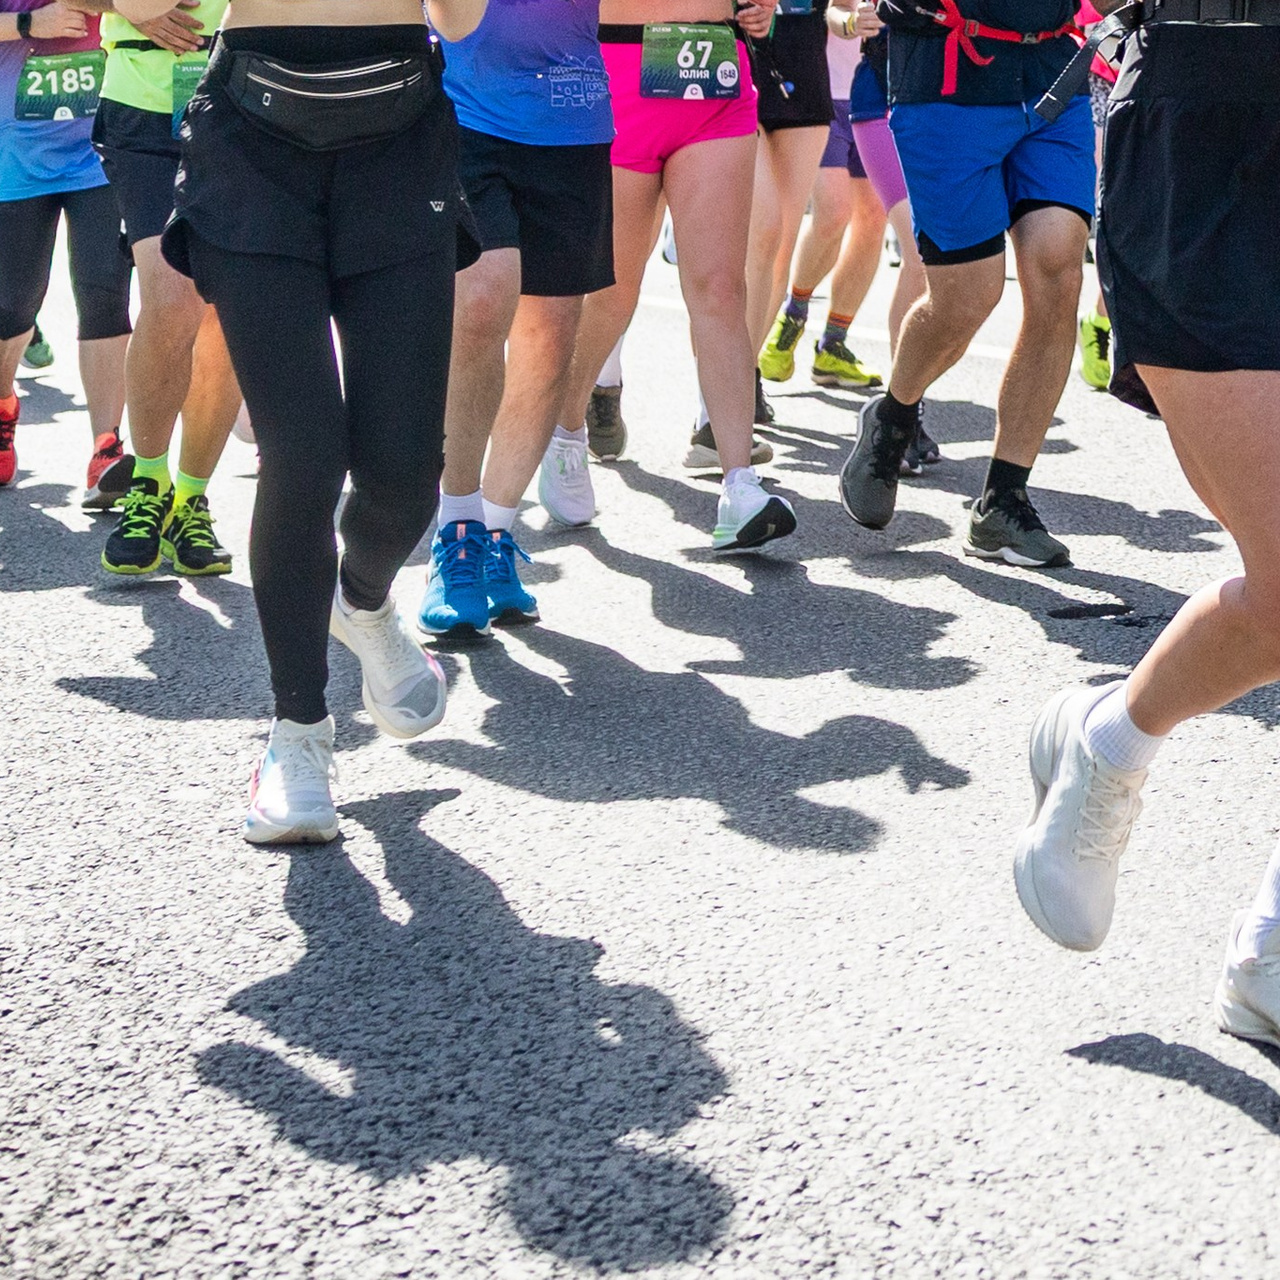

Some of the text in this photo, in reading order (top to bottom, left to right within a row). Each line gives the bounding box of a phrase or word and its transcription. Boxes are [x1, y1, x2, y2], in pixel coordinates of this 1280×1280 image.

[677, 40, 713, 69] 67
[27, 66, 96, 96] 2185
[679, 69, 710, 80] ЮЛИЯ
